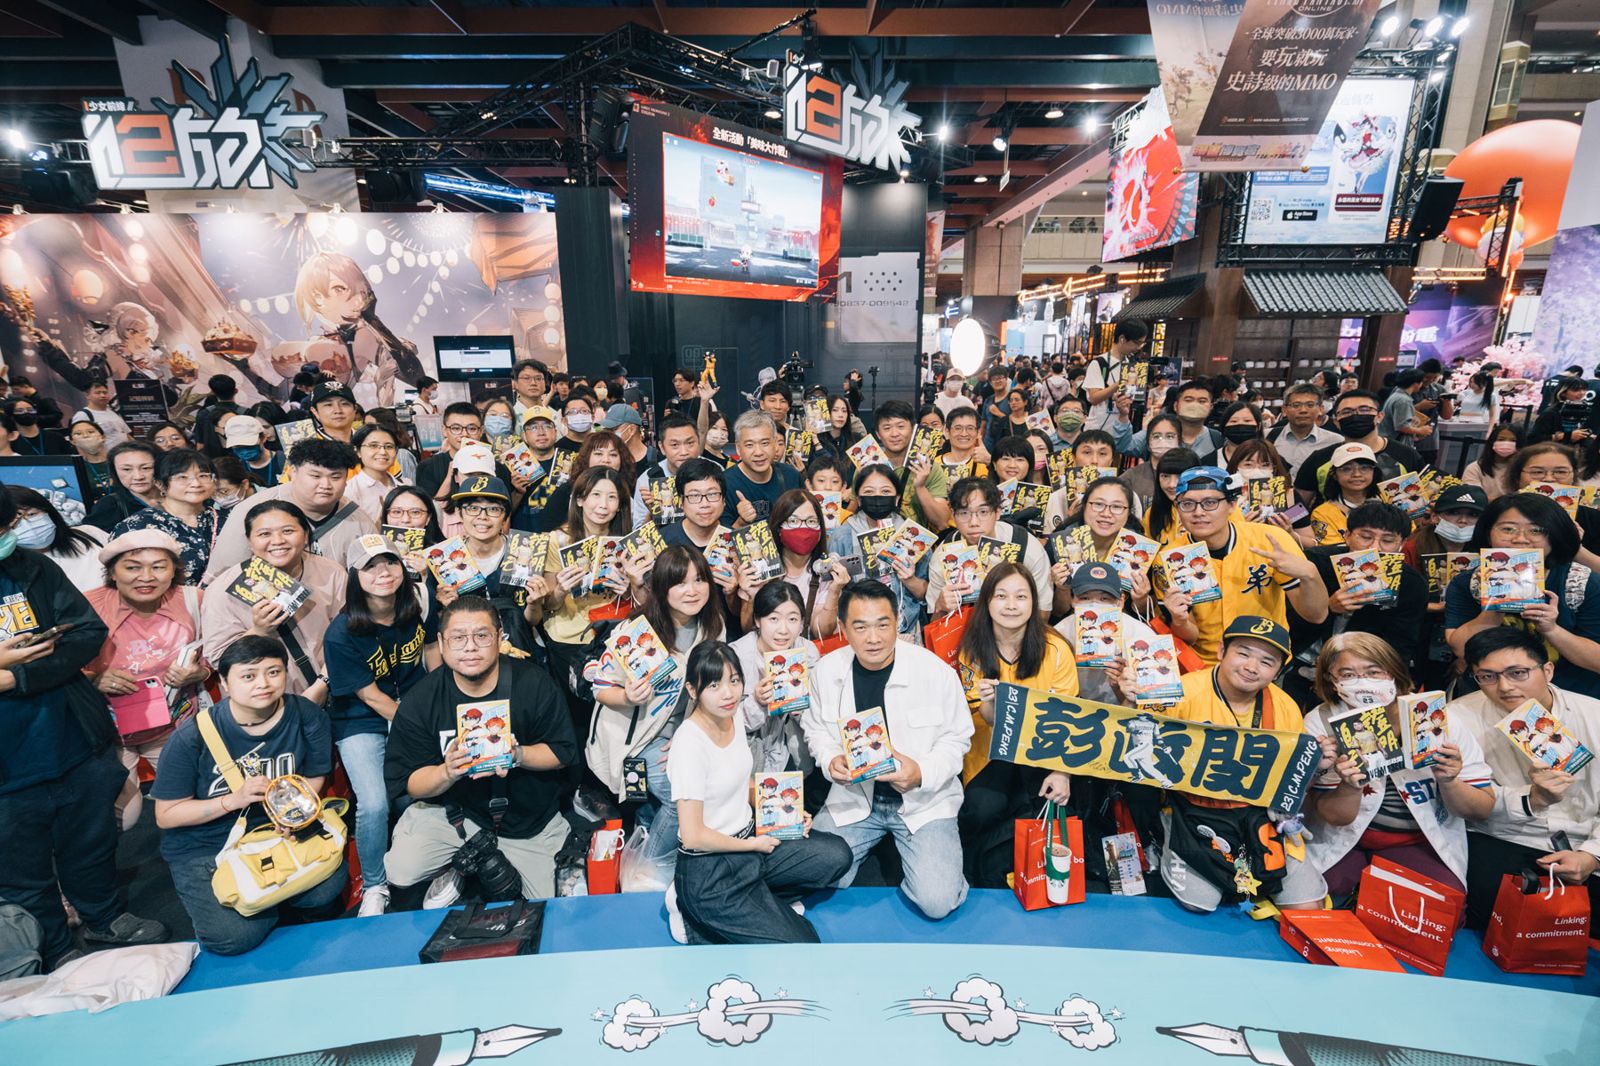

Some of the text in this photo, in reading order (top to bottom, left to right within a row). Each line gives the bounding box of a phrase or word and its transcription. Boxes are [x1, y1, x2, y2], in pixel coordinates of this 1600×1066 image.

[1257, 46, 1330, 68] 要玩就玩
[1223, 71, 1338, 95] 史詩級的MMO
[1241, 563, 1273, 595] 弟
[1360, 705, 1399, 752] 證明
[1525, 928, 1586, 939] commitment.
